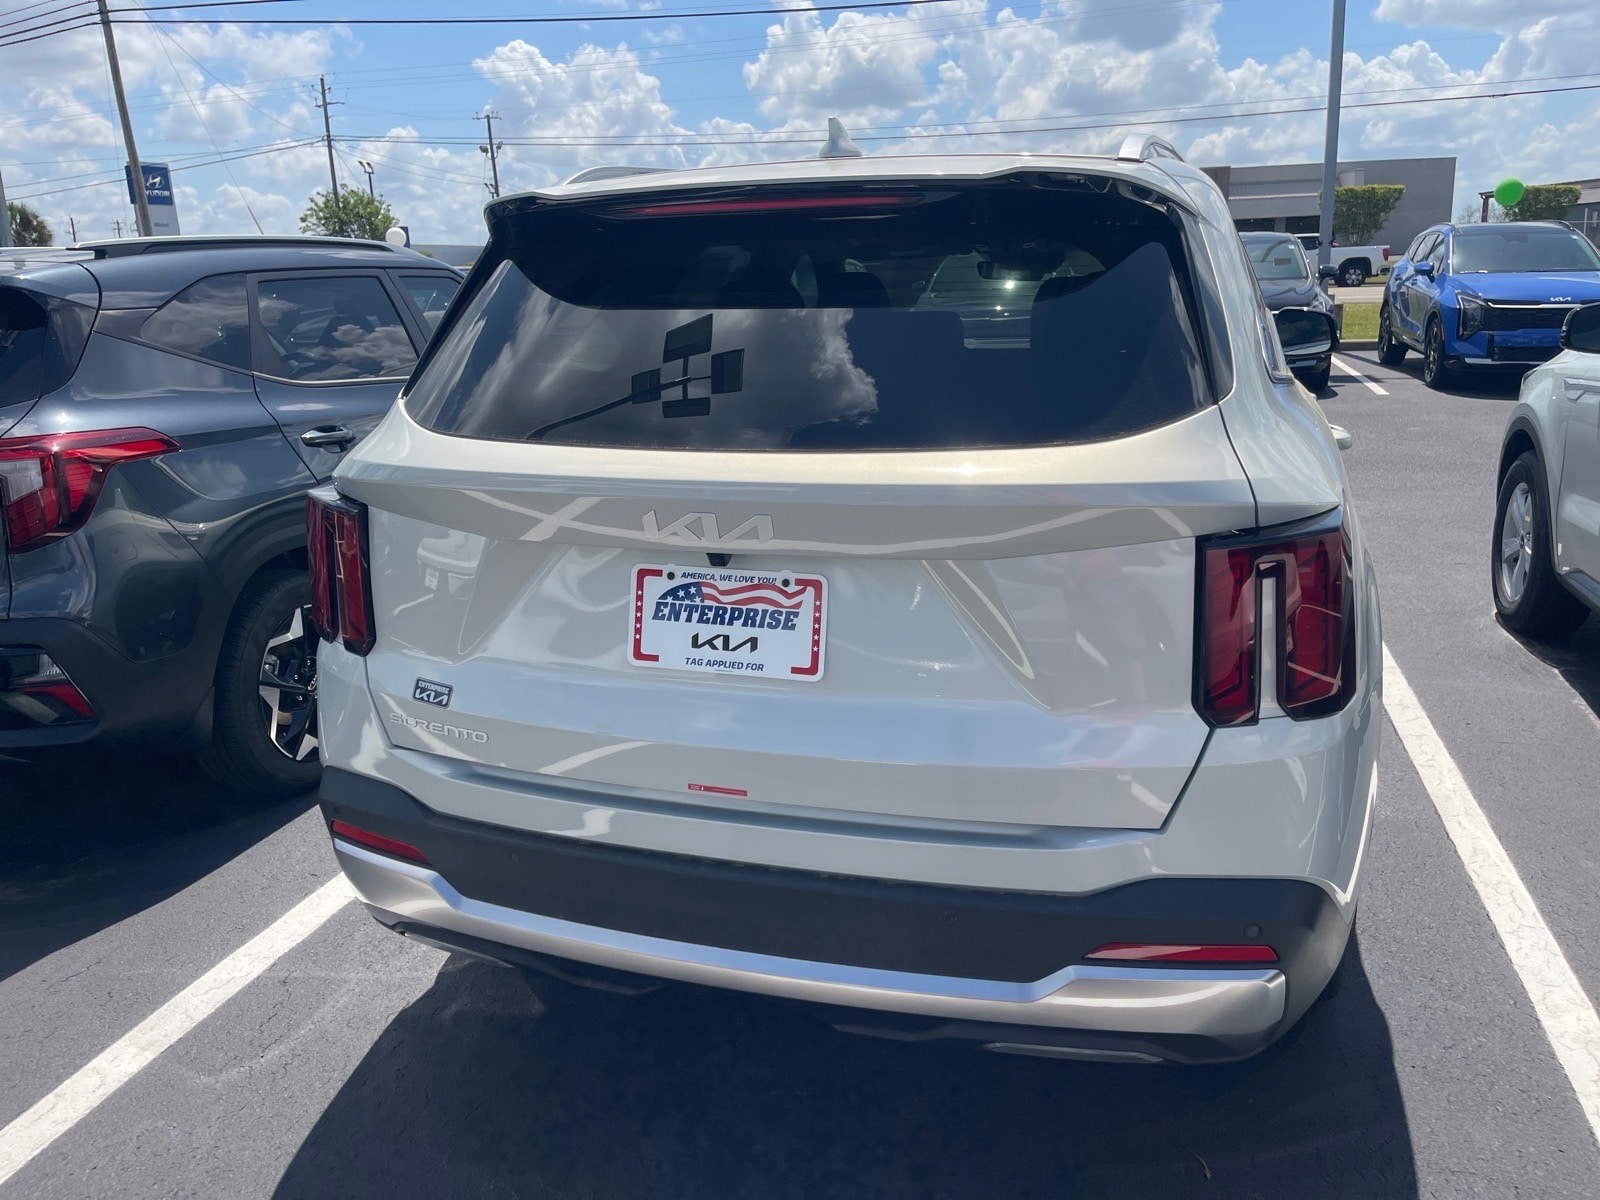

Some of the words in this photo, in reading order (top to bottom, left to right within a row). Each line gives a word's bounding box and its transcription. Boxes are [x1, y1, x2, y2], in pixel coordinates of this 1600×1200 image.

[641, 510, 775, 544] KIA
[681, 571, 717, 582] AMERICA,
[719, 574, 733, 582] WE
[734, 575, 756, 584] LOVE
[757, 576, 777, 585] YOU!
[652, 601, 800, 631] ENTERPRISE
[691, 632, 759, 653] KIA
[685, 657, 704, 666] TAG
[705, 659, 744, 670] APPLIED
[745, 662, 765, 672] FOR
[414, 687, 449, 705] KIA
[390, 712, 489, 743] SORENTO
